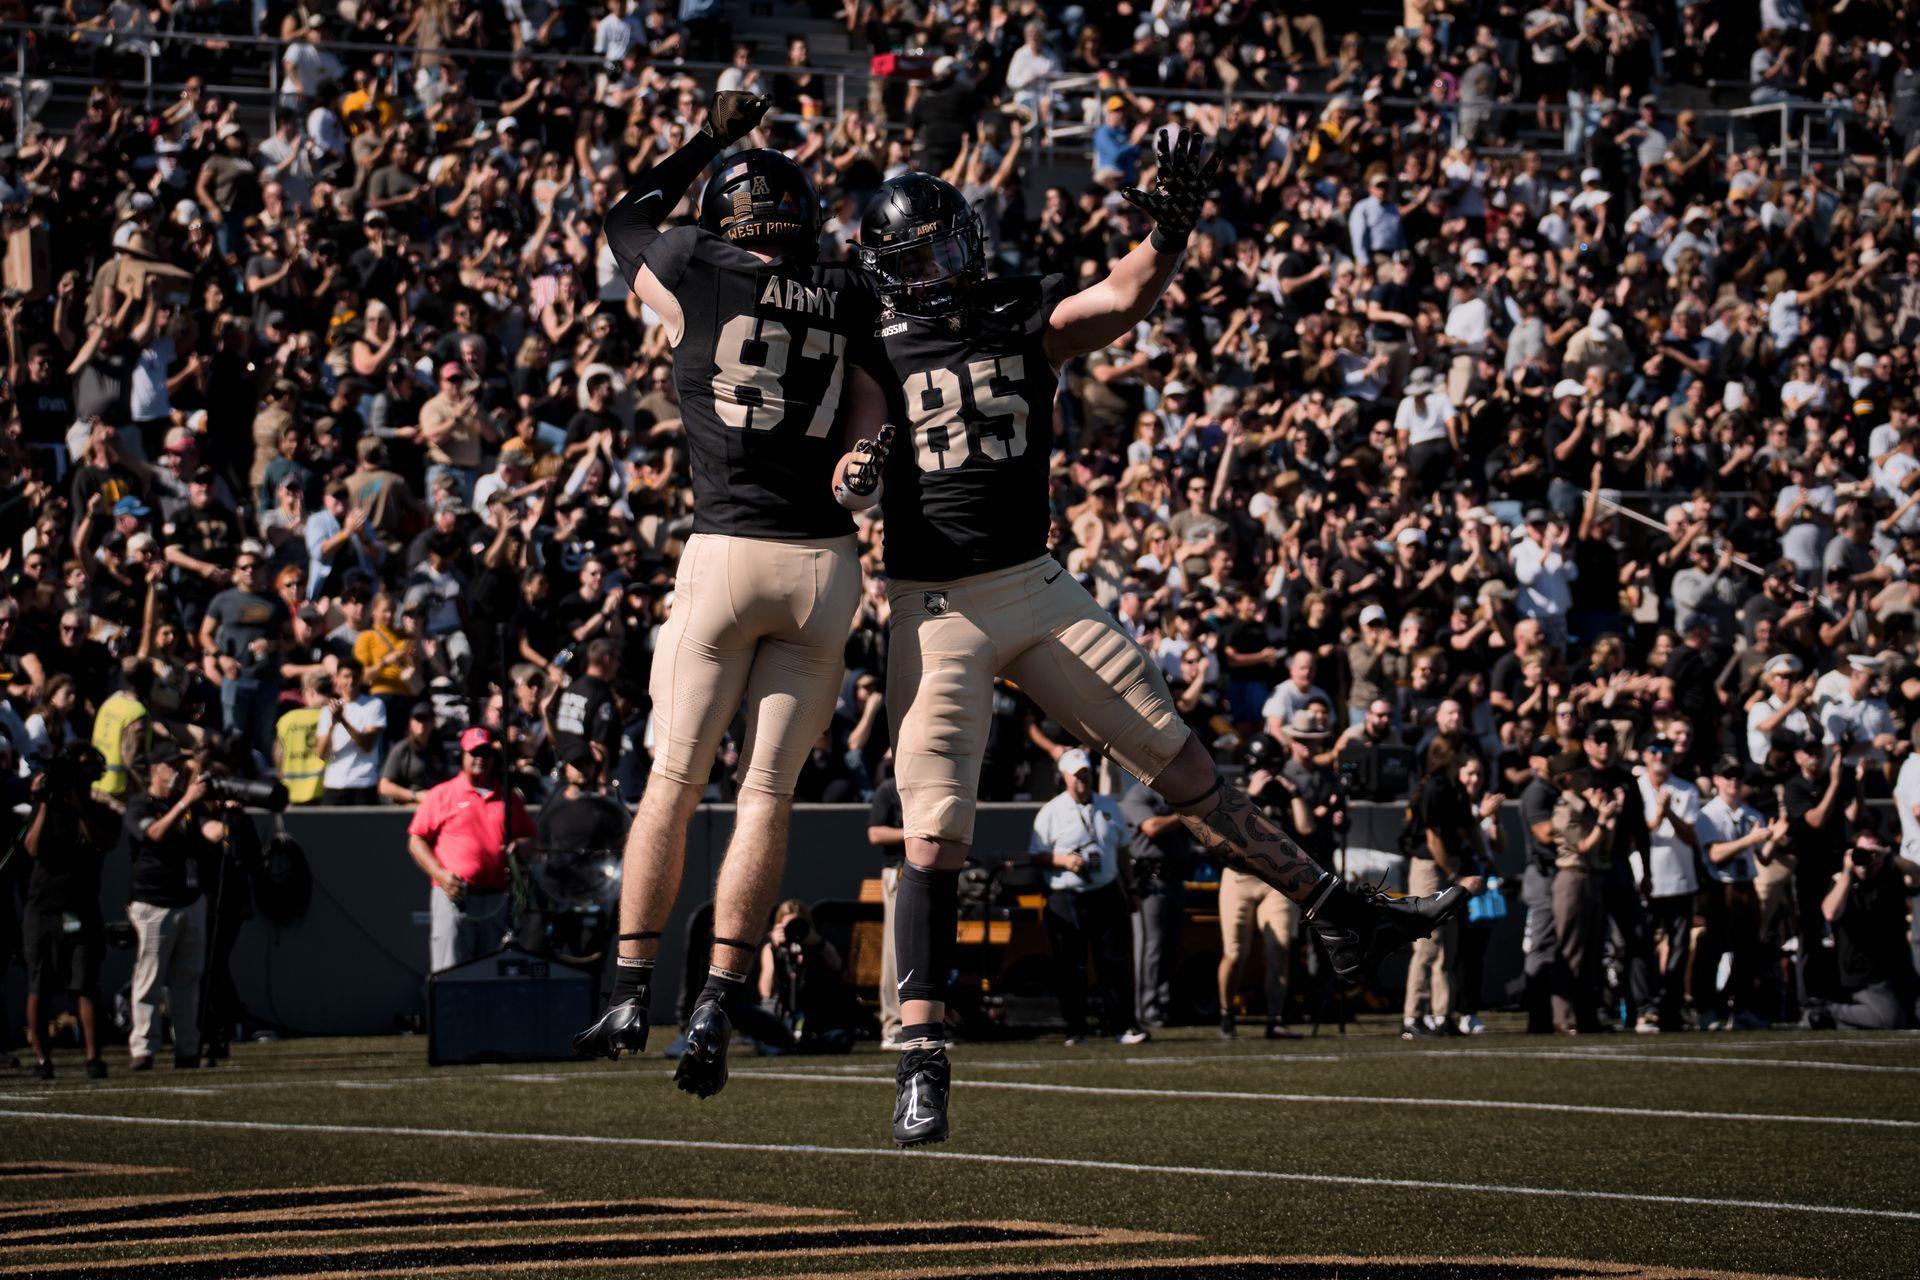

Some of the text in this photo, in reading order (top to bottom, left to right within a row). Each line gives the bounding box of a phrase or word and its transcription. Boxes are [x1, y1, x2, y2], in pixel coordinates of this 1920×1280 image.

[727, 222, 762, 240] WEST
[917, 221, 937, 236] ARMY
[760, 275, 839, 319] ARMY
[711, 314, 848, 439] 87
[902, 354, 1030, 473] 85
